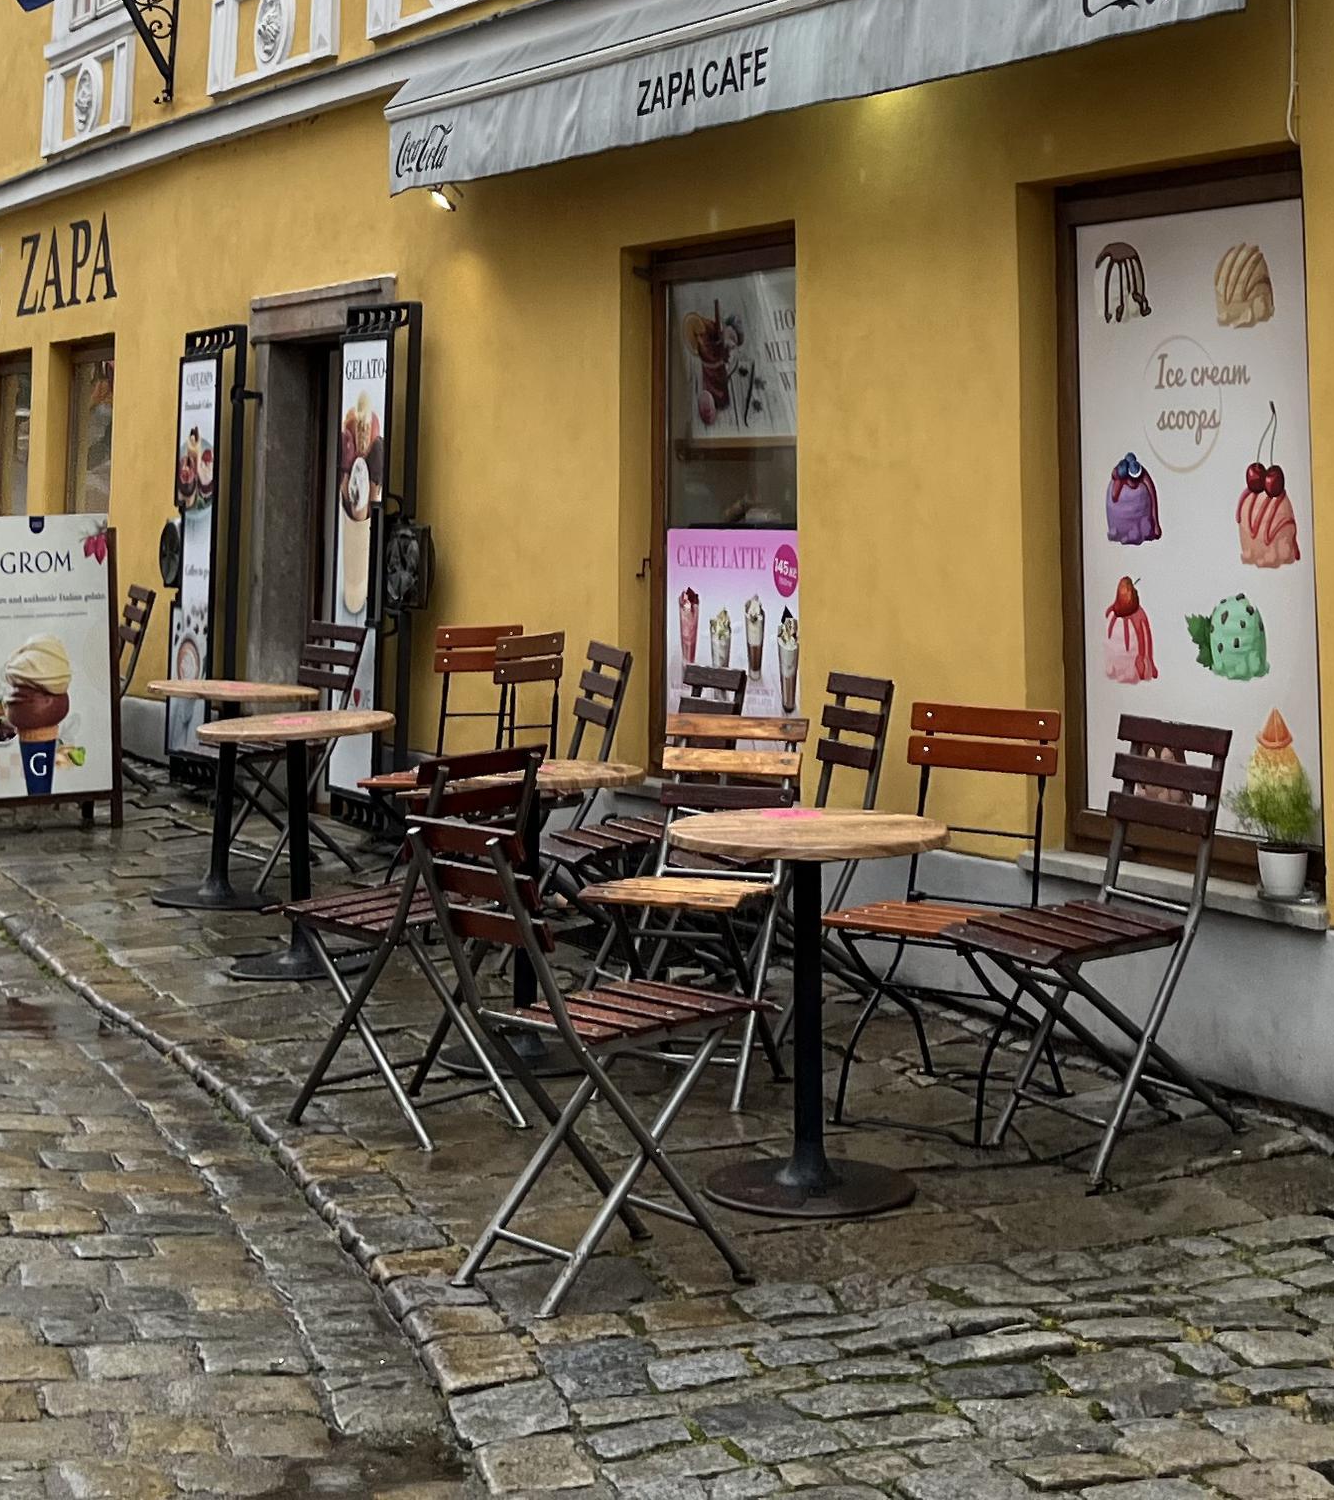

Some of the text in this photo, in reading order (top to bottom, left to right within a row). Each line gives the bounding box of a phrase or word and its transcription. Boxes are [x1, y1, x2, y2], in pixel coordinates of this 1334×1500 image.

[637, 47, 769, 117] ZAPA CAFE
[16, 211, 117, 317] ZAPA
[345, 357, 386, 380] GELATO
[1154, 353, 1251, 390] Ice cream
[1155, 408, 1221, 446] scoops
[0, 549, 73, 575] GROM
[722, 546, 766, 571] LATTE
[30, 752, 47, 776] G
